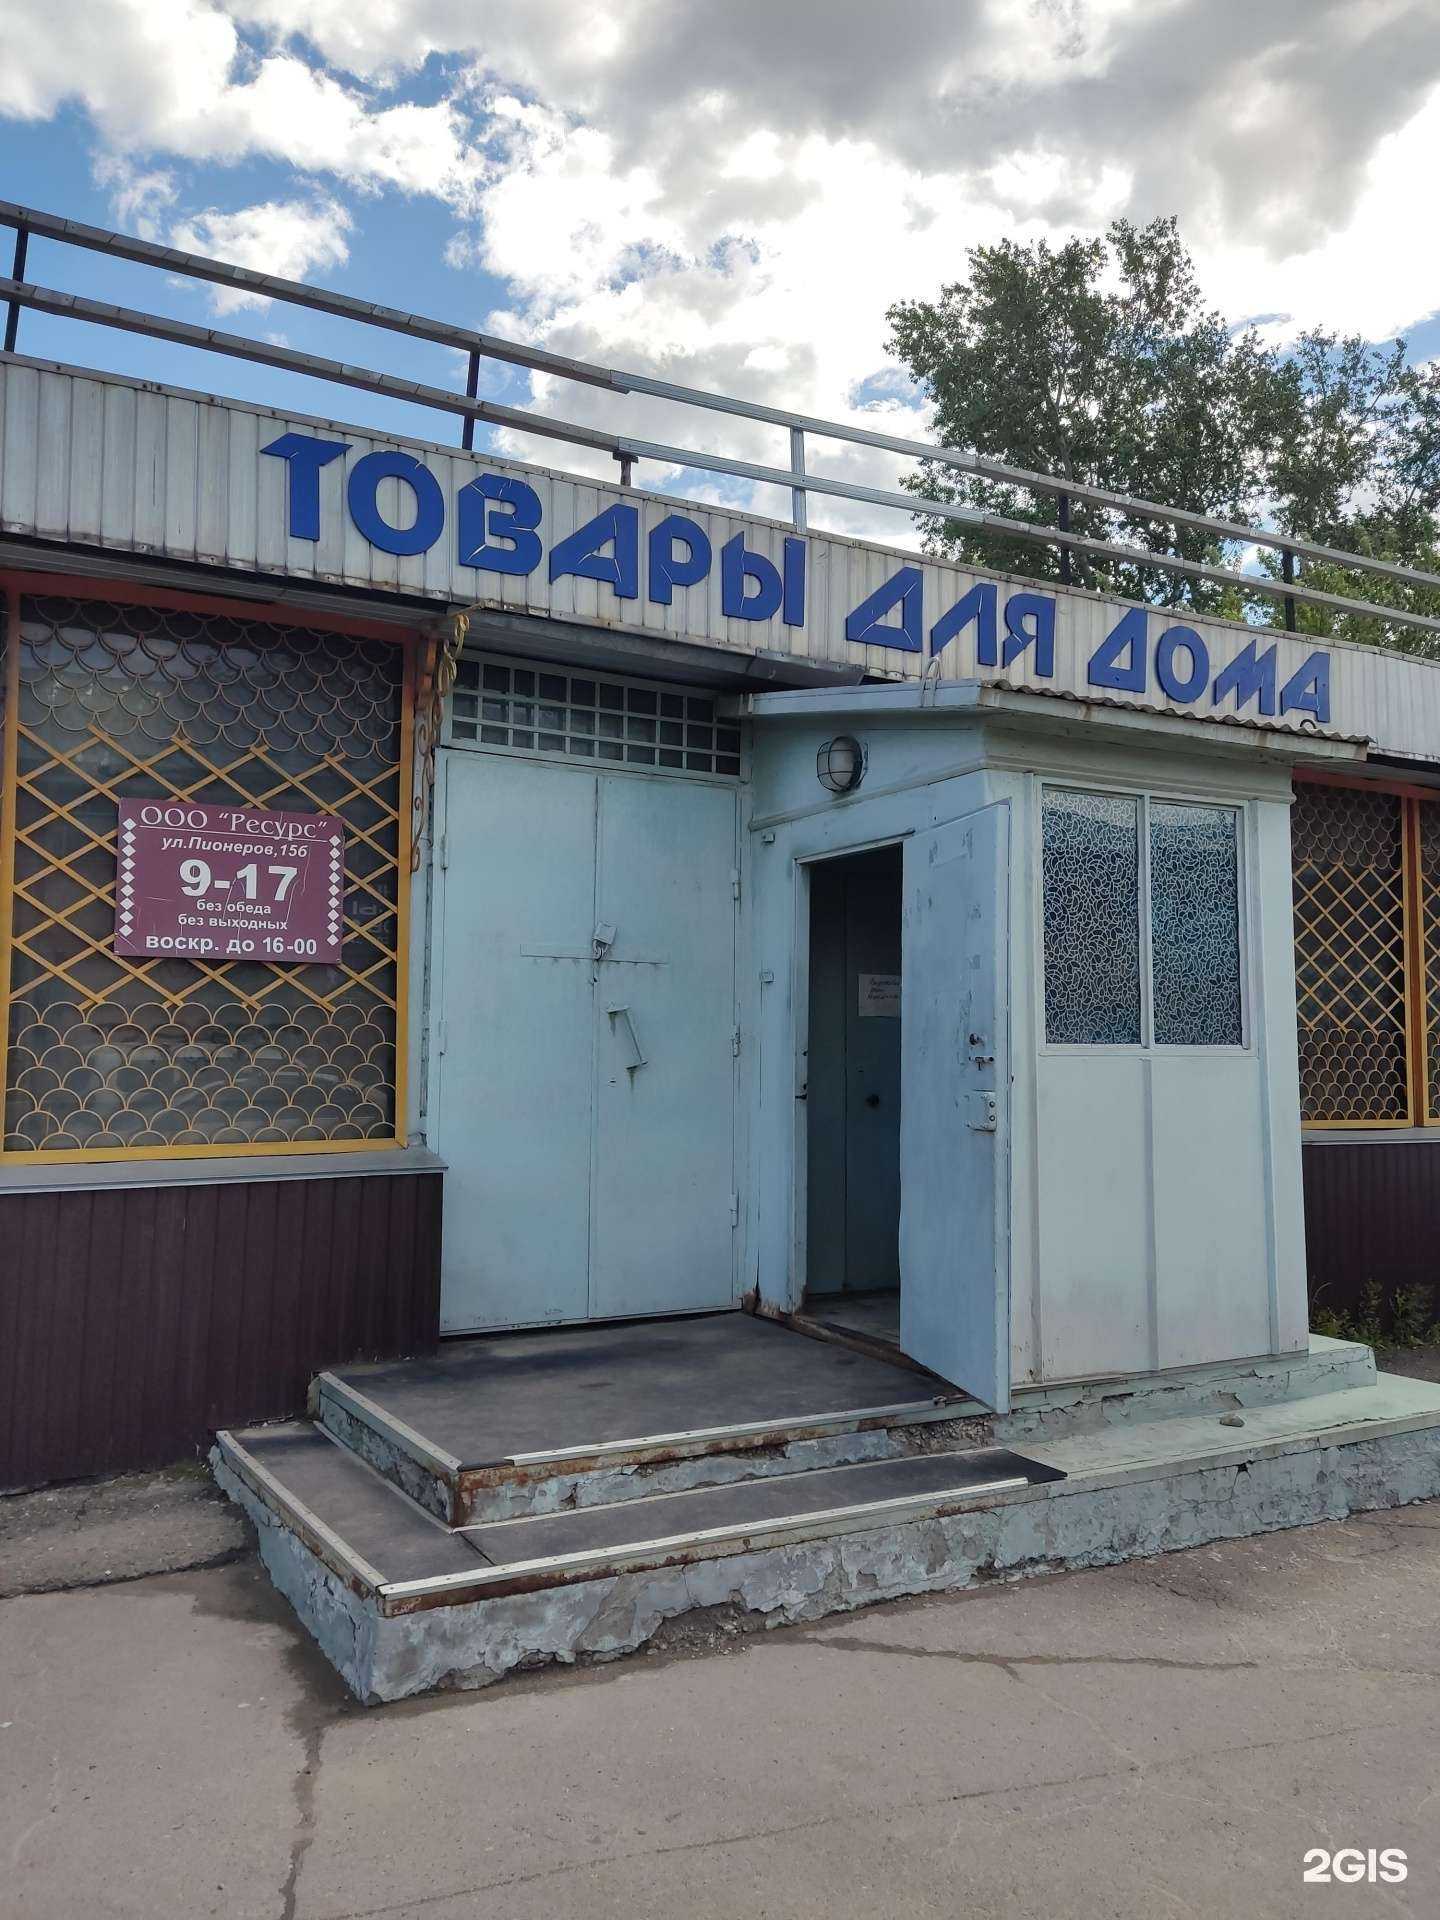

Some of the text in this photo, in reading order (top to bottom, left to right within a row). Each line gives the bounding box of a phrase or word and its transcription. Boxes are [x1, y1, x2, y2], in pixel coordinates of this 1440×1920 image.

[260, 432, 1331, 723] ТОВАРЫ ДЛЯ ДОМА
[140, 806, 328, 841] ООО "Ресурс"
[179, 859, 298, 901] 9-17
[196, 900, 271, 915] без обеда
[178, 914, 288, 930] без выходных
[145, 935, 317, 955] воскр. до 16-00
